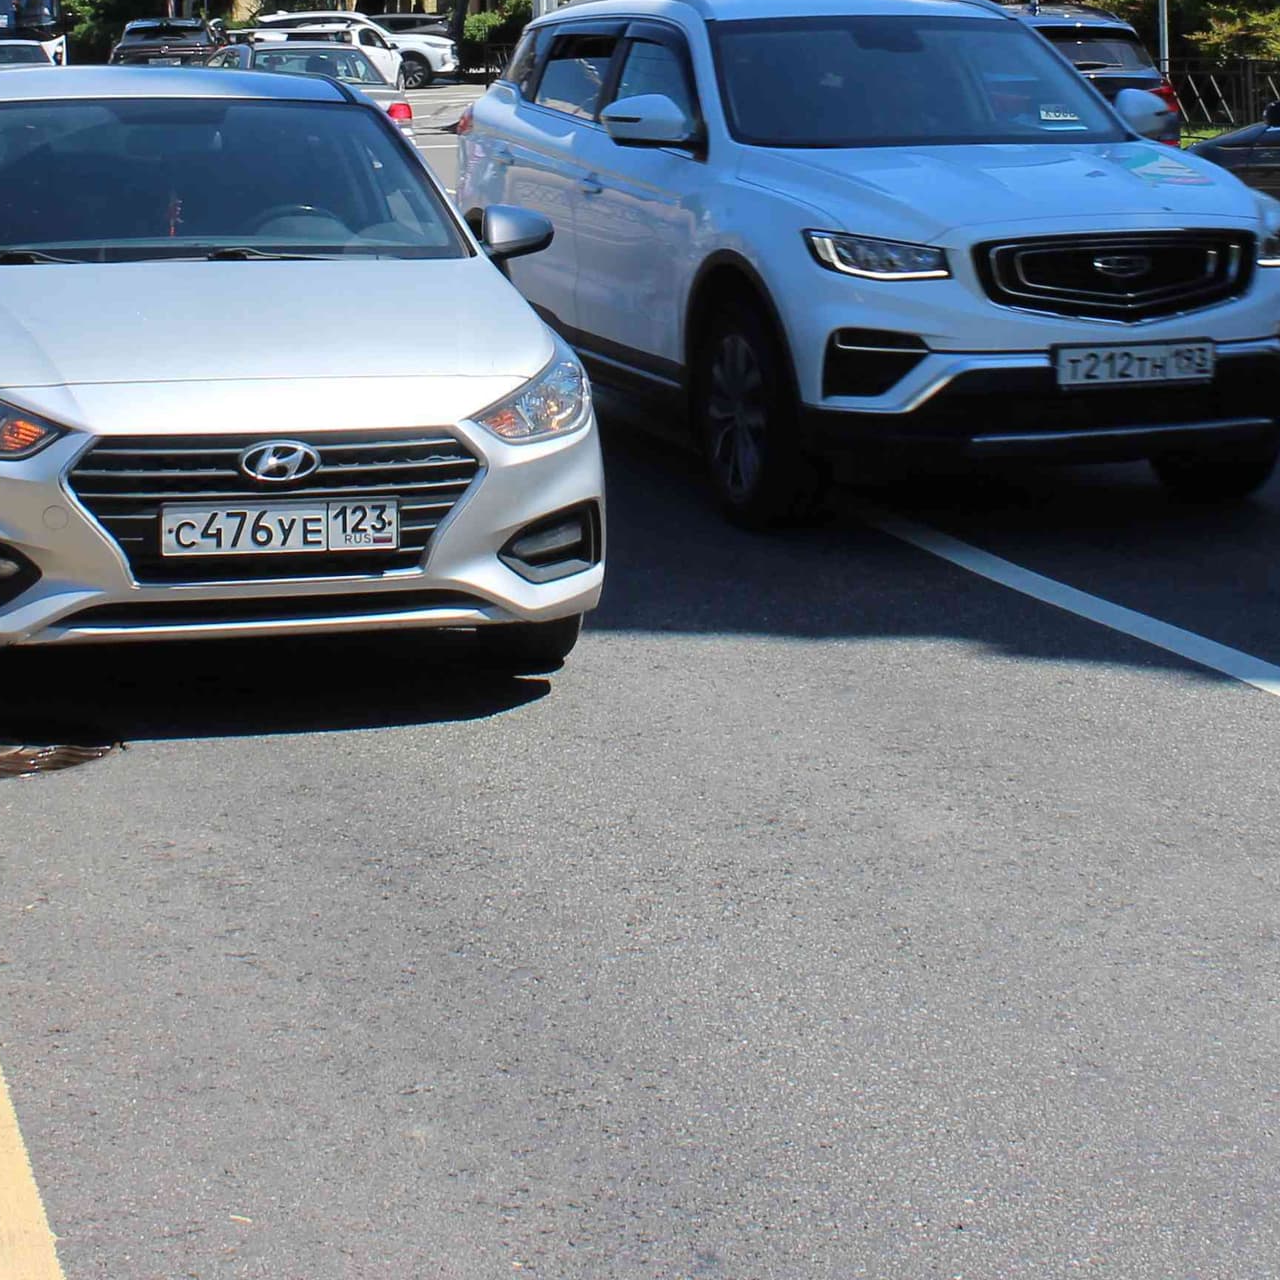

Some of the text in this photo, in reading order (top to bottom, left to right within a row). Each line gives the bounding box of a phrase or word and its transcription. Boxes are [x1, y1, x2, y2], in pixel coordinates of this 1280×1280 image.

[175, 505, 388, 548] С476УЕ 123
[345, 533, 372, 544] RUS
